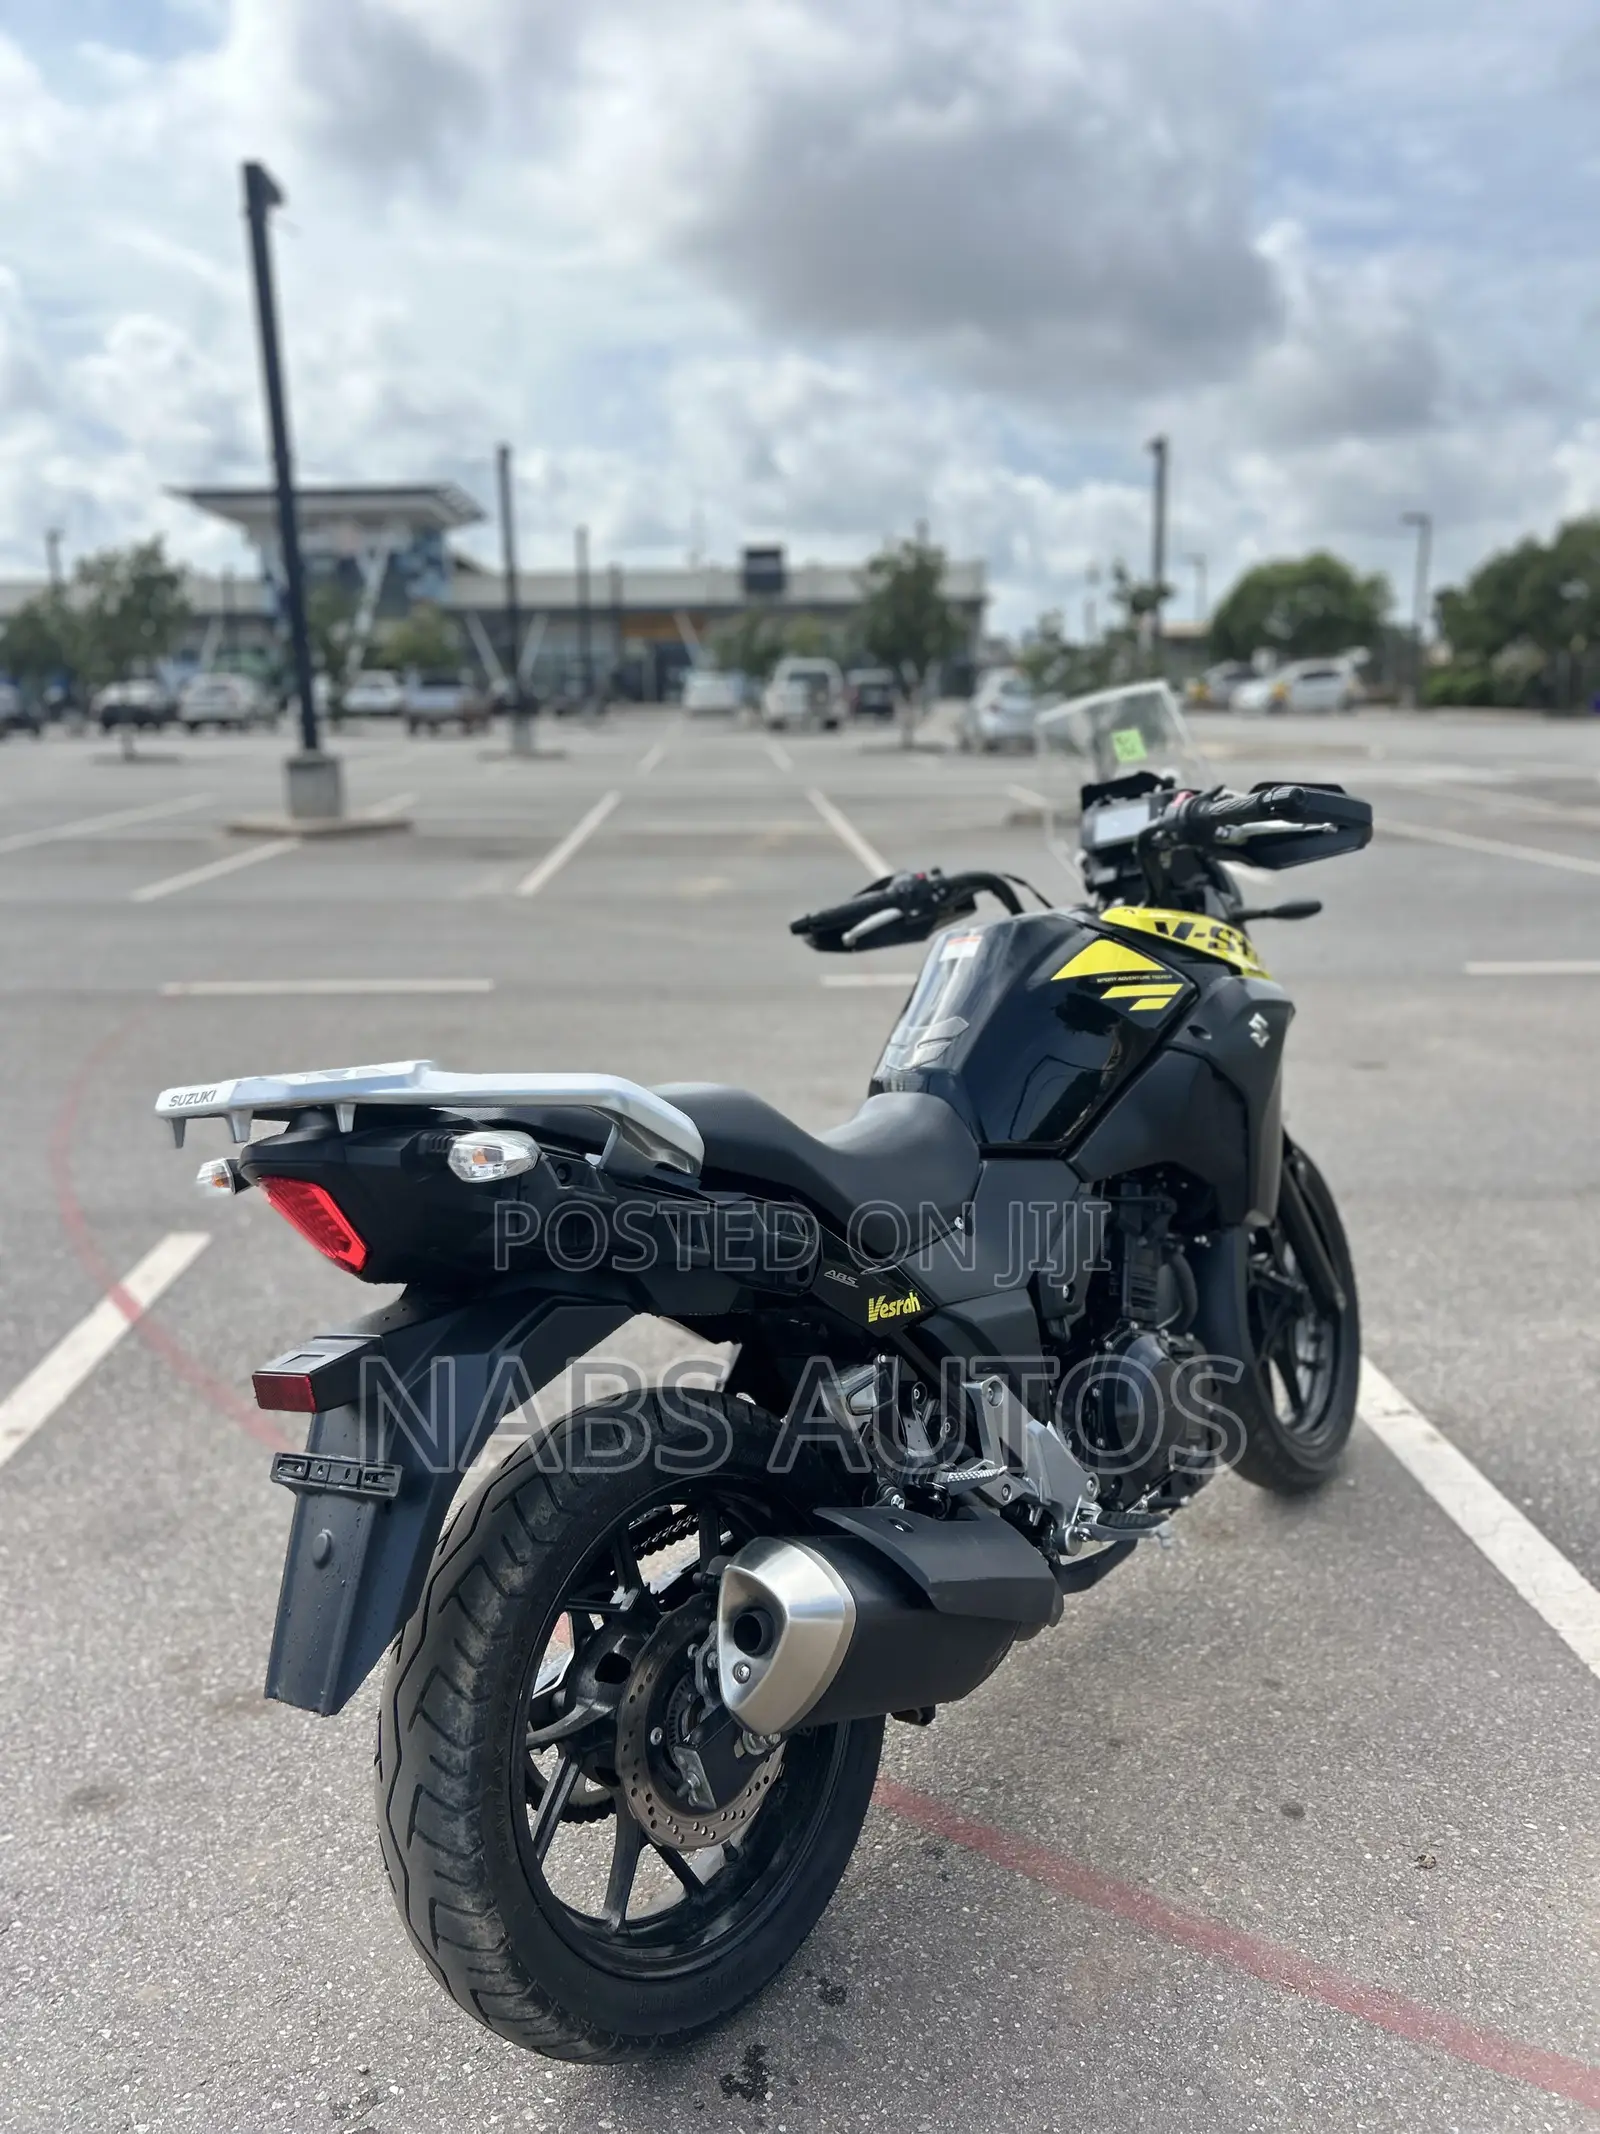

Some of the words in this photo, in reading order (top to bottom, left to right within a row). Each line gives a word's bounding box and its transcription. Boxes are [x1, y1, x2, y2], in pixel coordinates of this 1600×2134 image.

[168, 1089, 217, 1107] SUZUKI
[823, 1269, 859, 1288] ABS
[868, 1291, 921, 1323] Vesrah
